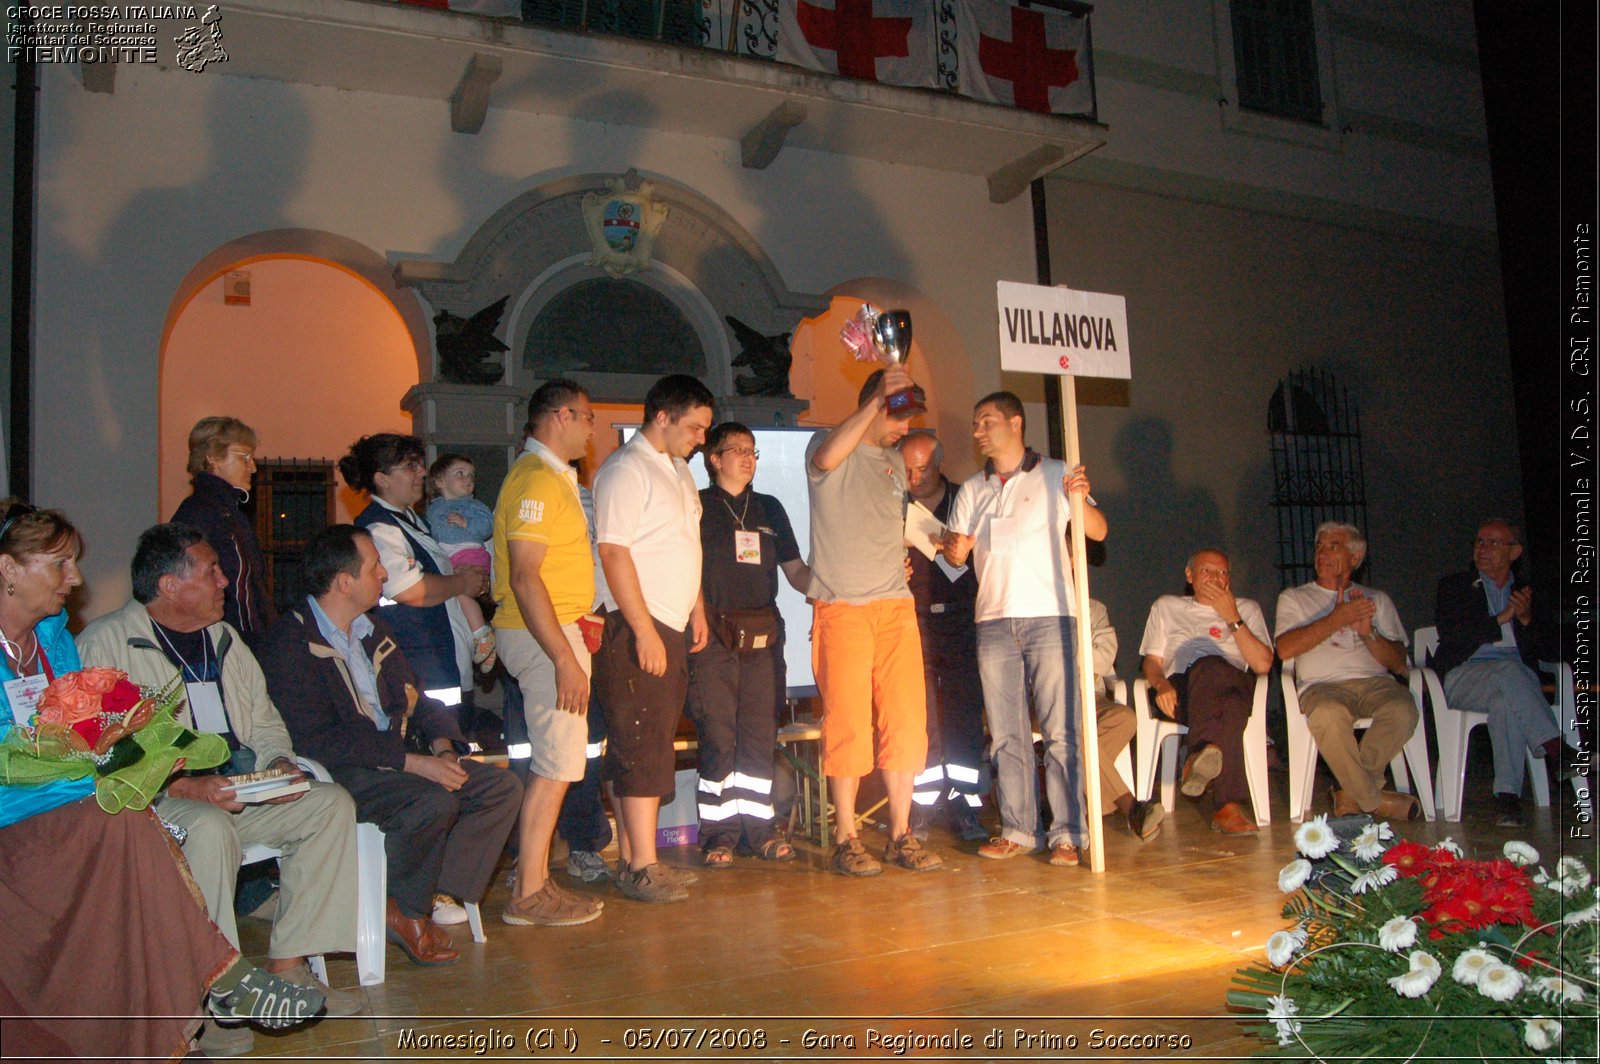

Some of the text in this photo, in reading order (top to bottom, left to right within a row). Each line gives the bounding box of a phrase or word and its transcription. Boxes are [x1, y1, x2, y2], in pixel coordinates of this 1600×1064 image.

[1004, 307, 1118, 352] VILLANOVA
[521, 499, 544, 511] WILD
[518, 509, 543, 523] SAILS
[662, 829, 680, 839] Copy
